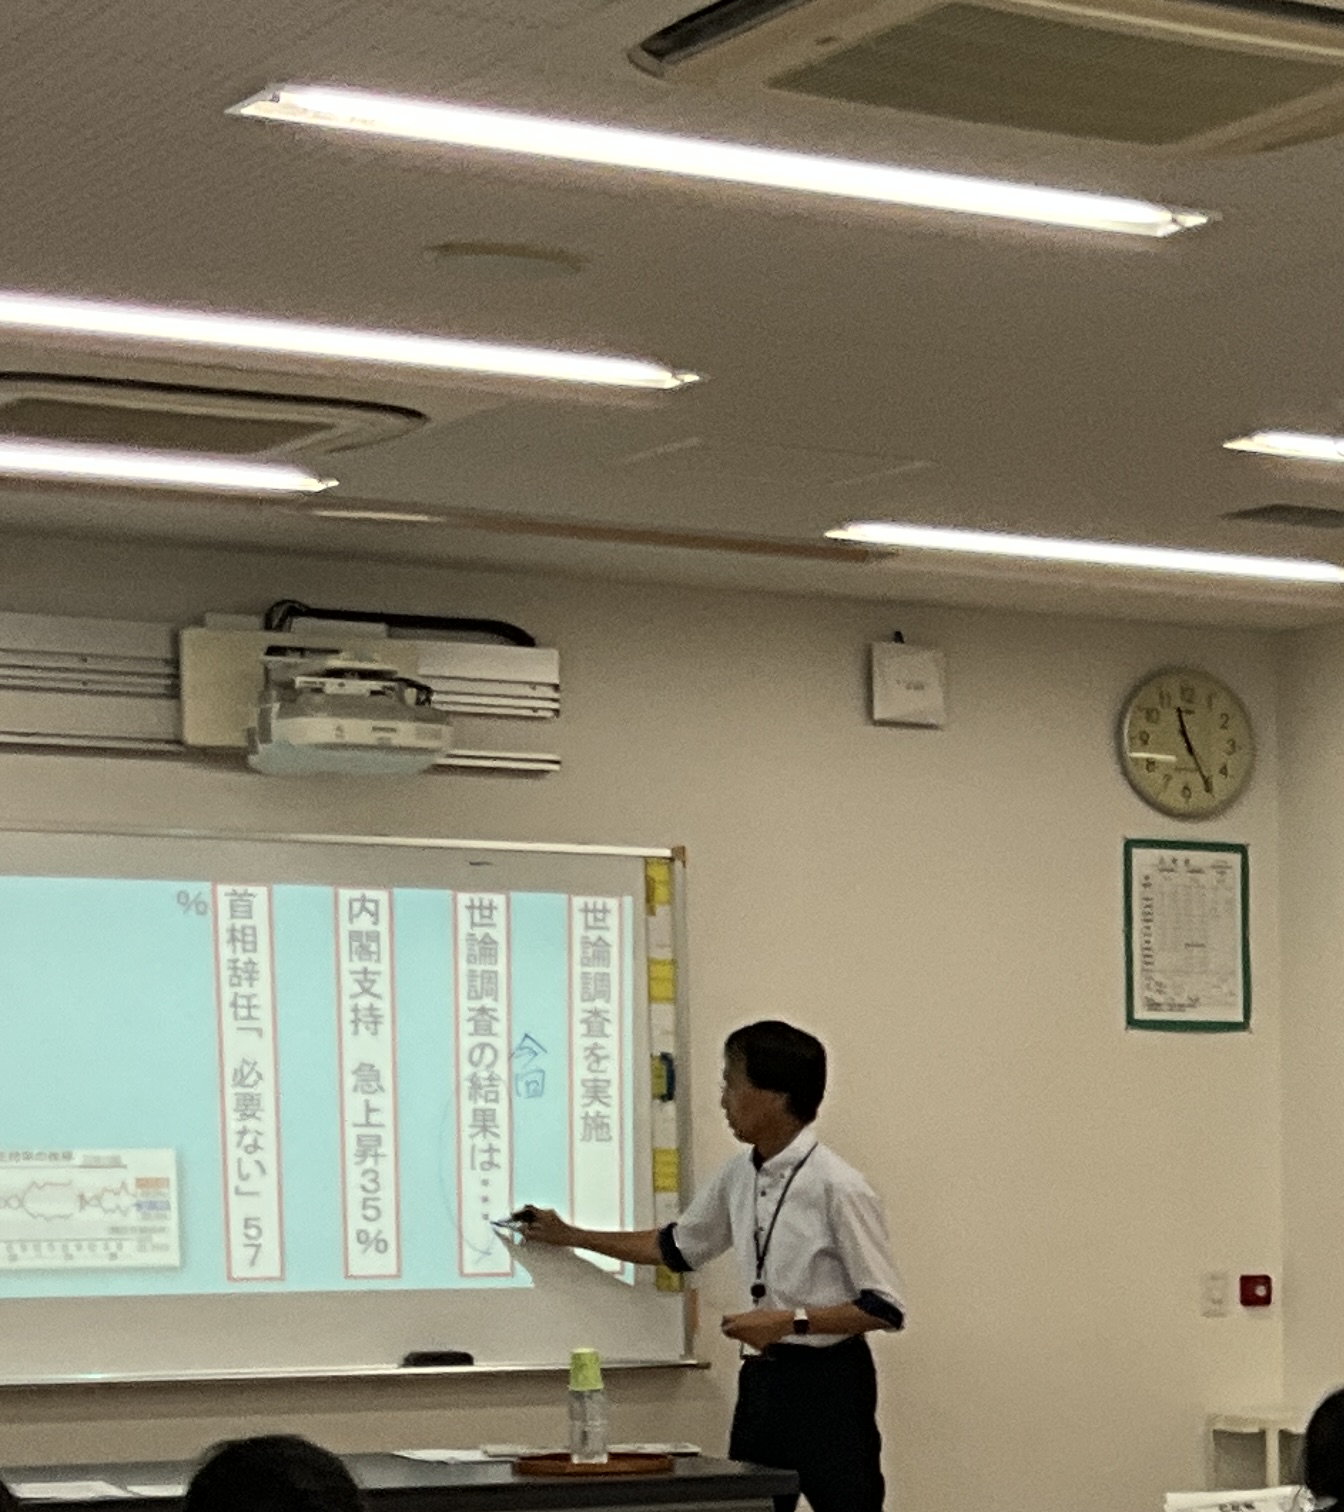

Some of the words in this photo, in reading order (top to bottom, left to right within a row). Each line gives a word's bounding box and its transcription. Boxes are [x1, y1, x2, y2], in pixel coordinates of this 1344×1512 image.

[1219, 713, 1230, 730] 2
[176, 889, 208, 917] %
[348, 892, 385, 1037] 内閣支持
[577, 900, 613, 1143] 世論調査を実施
